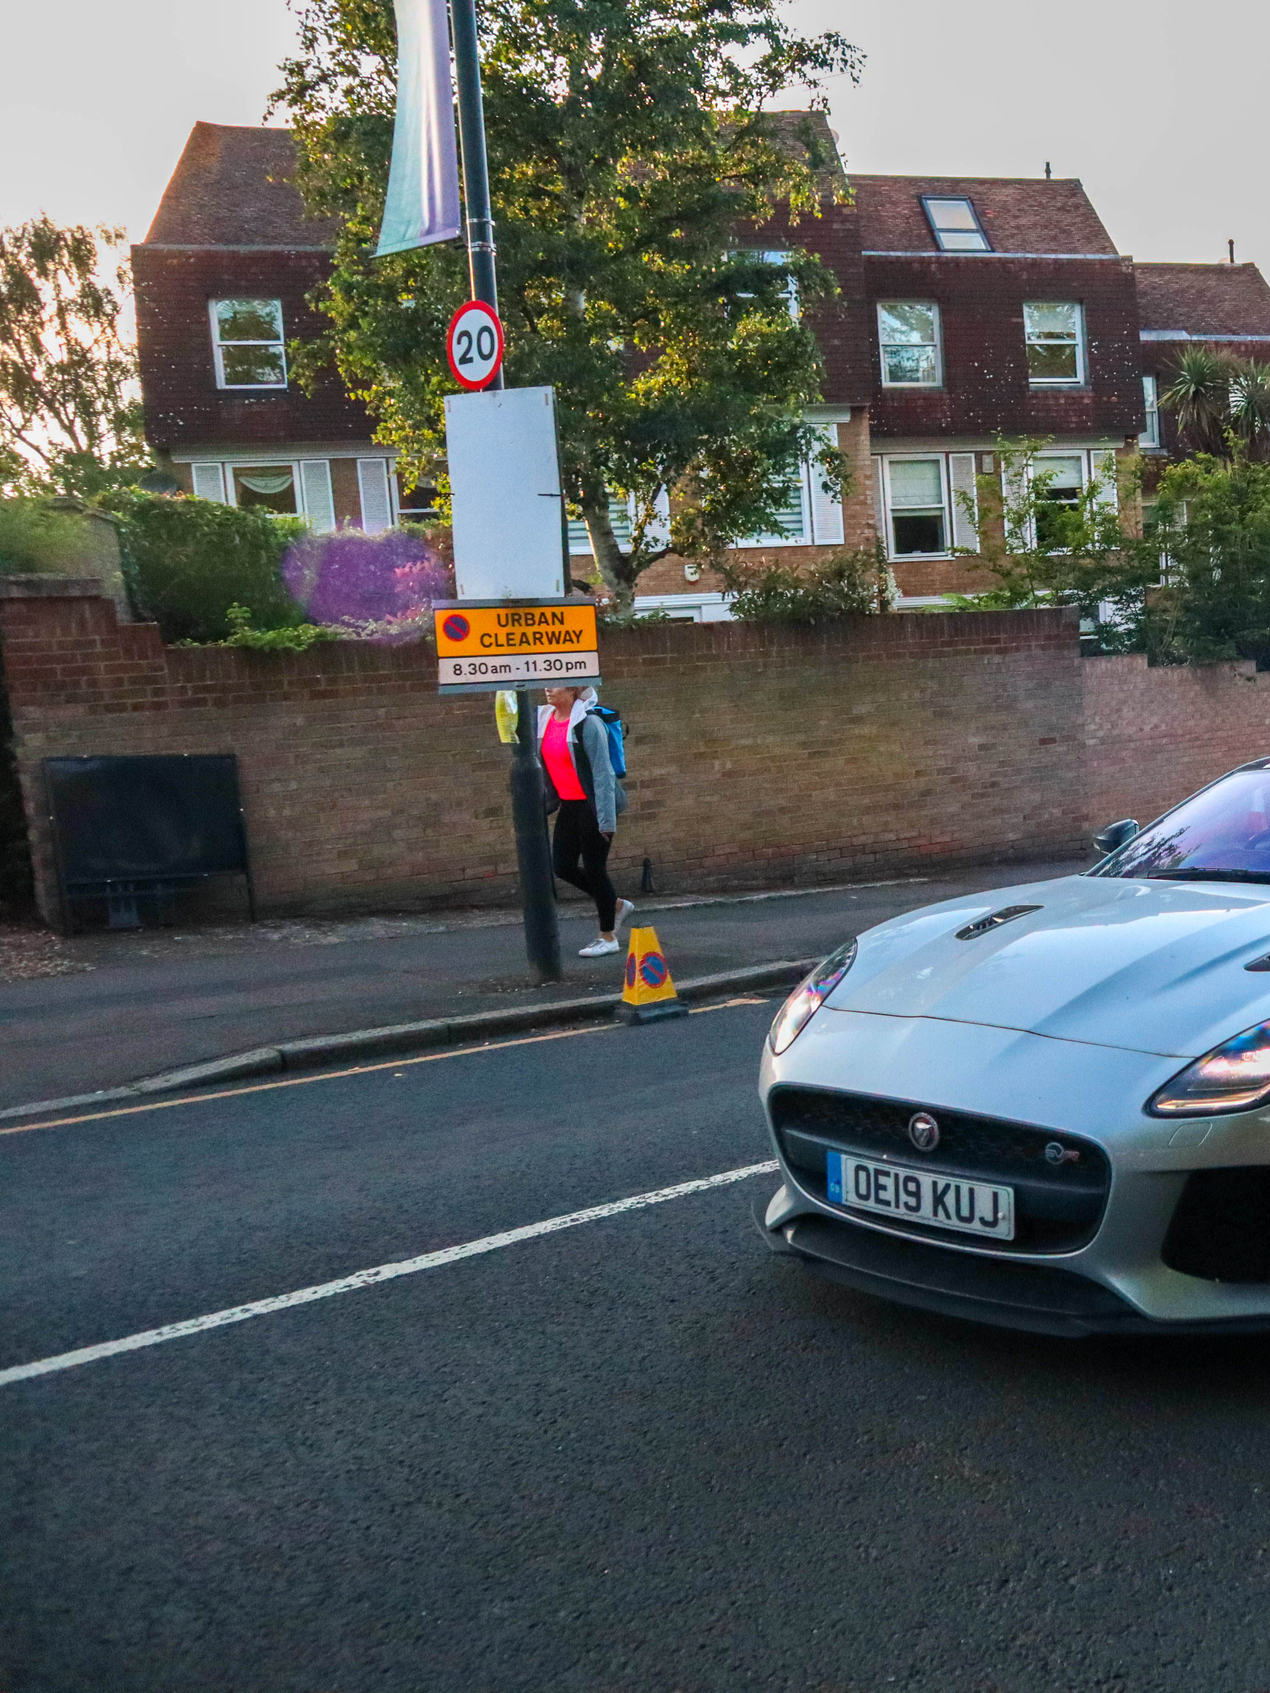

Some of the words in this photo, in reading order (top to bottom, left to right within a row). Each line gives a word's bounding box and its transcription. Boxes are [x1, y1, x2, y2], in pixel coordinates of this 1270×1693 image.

[456, 324, 495, 366] 20
[497, 611, 565, 628] URBAN
[480, 629, 583, 648] CLEARWAY
[854, 1163, 922, 1213] OE19
[932, 1179, 999, 1229] KUJ
